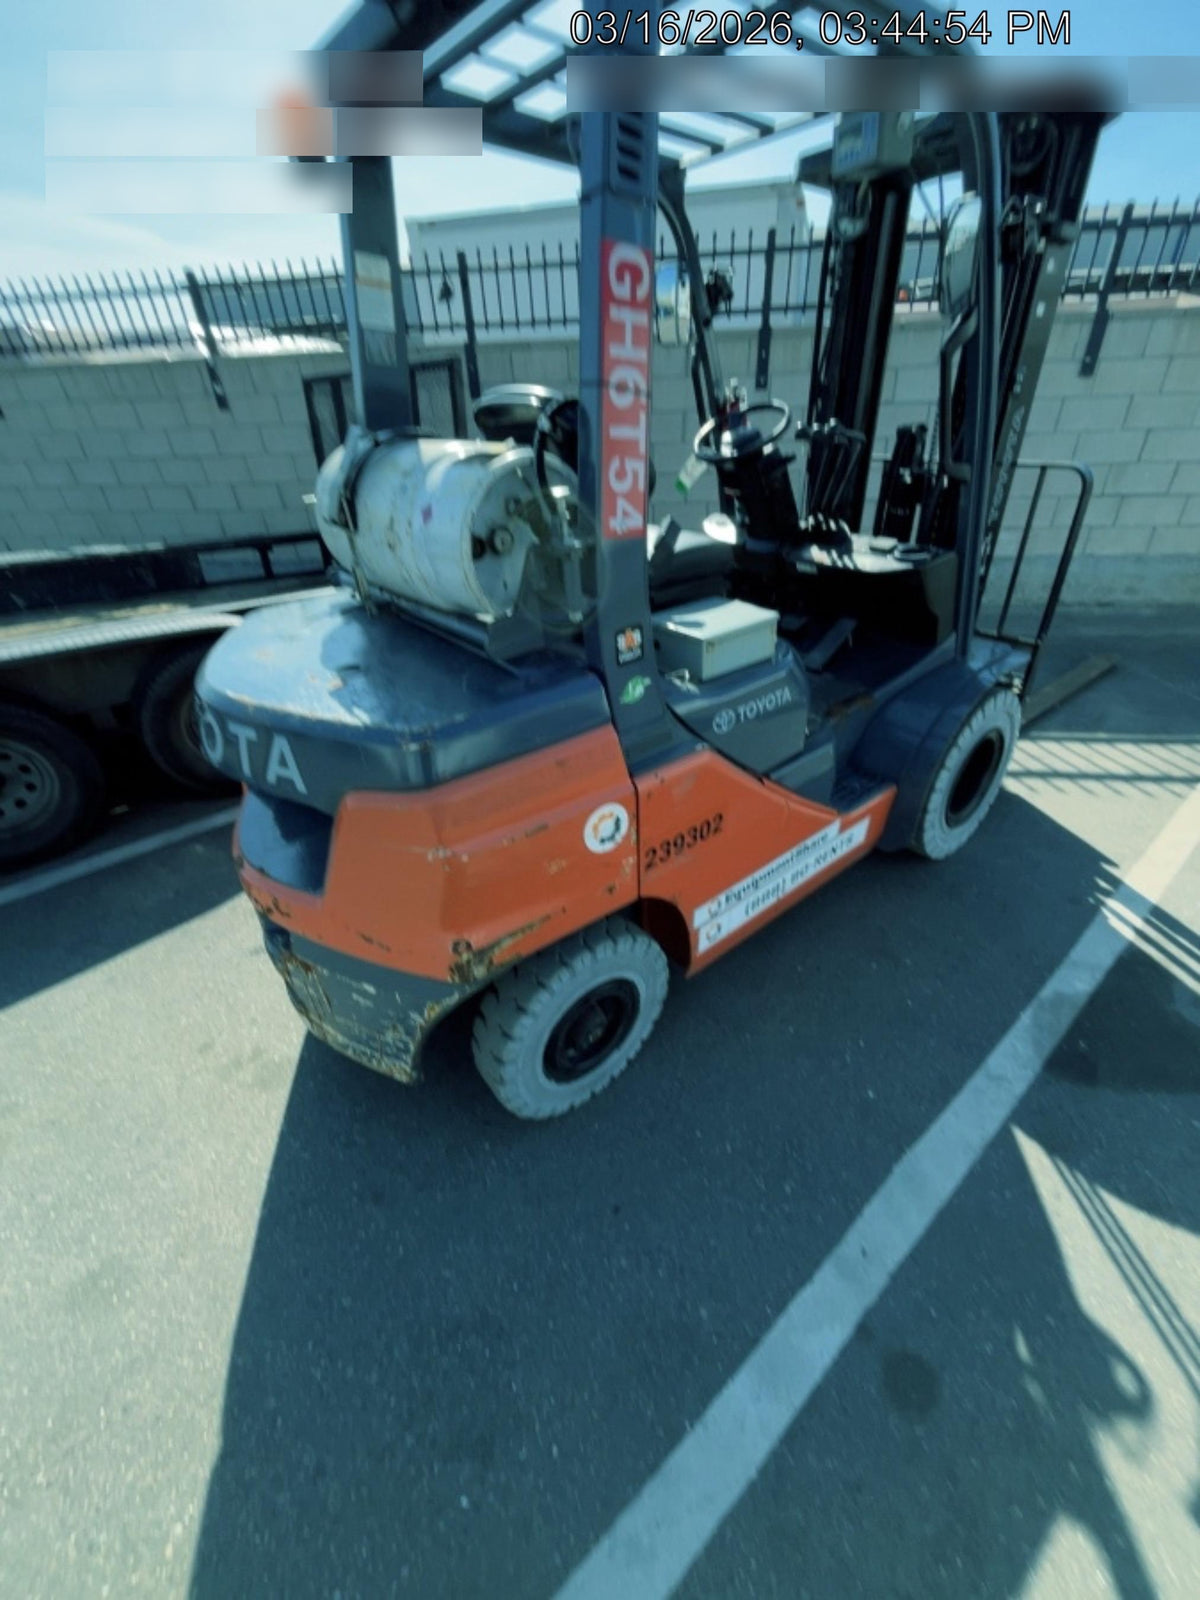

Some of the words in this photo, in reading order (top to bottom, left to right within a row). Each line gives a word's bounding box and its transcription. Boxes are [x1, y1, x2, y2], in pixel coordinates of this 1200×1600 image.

[608, 242, 650, 536] GH6T54
[738, 686, 792, 725] TOYOTA
[195, 697, 308, 795] OTA
[645, 812, 723, 873] 239302
